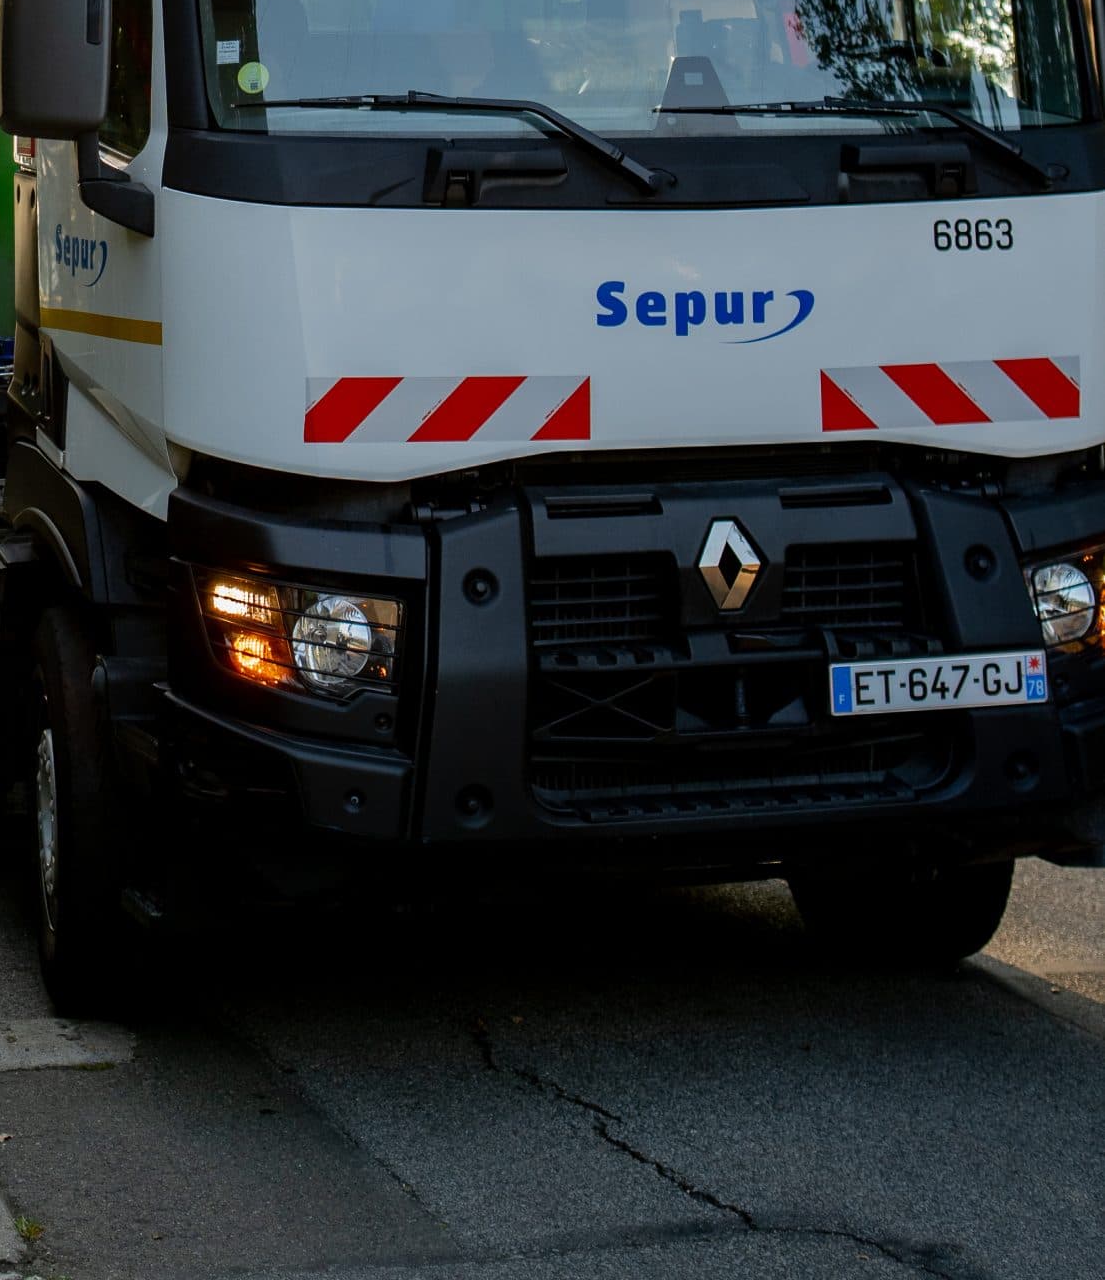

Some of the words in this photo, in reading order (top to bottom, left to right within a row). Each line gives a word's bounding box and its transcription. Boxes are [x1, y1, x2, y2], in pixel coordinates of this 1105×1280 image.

[55, 223, 96, 277] Sepur
[933, 219, 1014, 251] 6863
[596, 280, 774, 337] Sepur
[838, 694, 846, 705] F
[854, 661, 1024, 706] ET-647-GJ
[1027, 679, 1045, 697] 78
